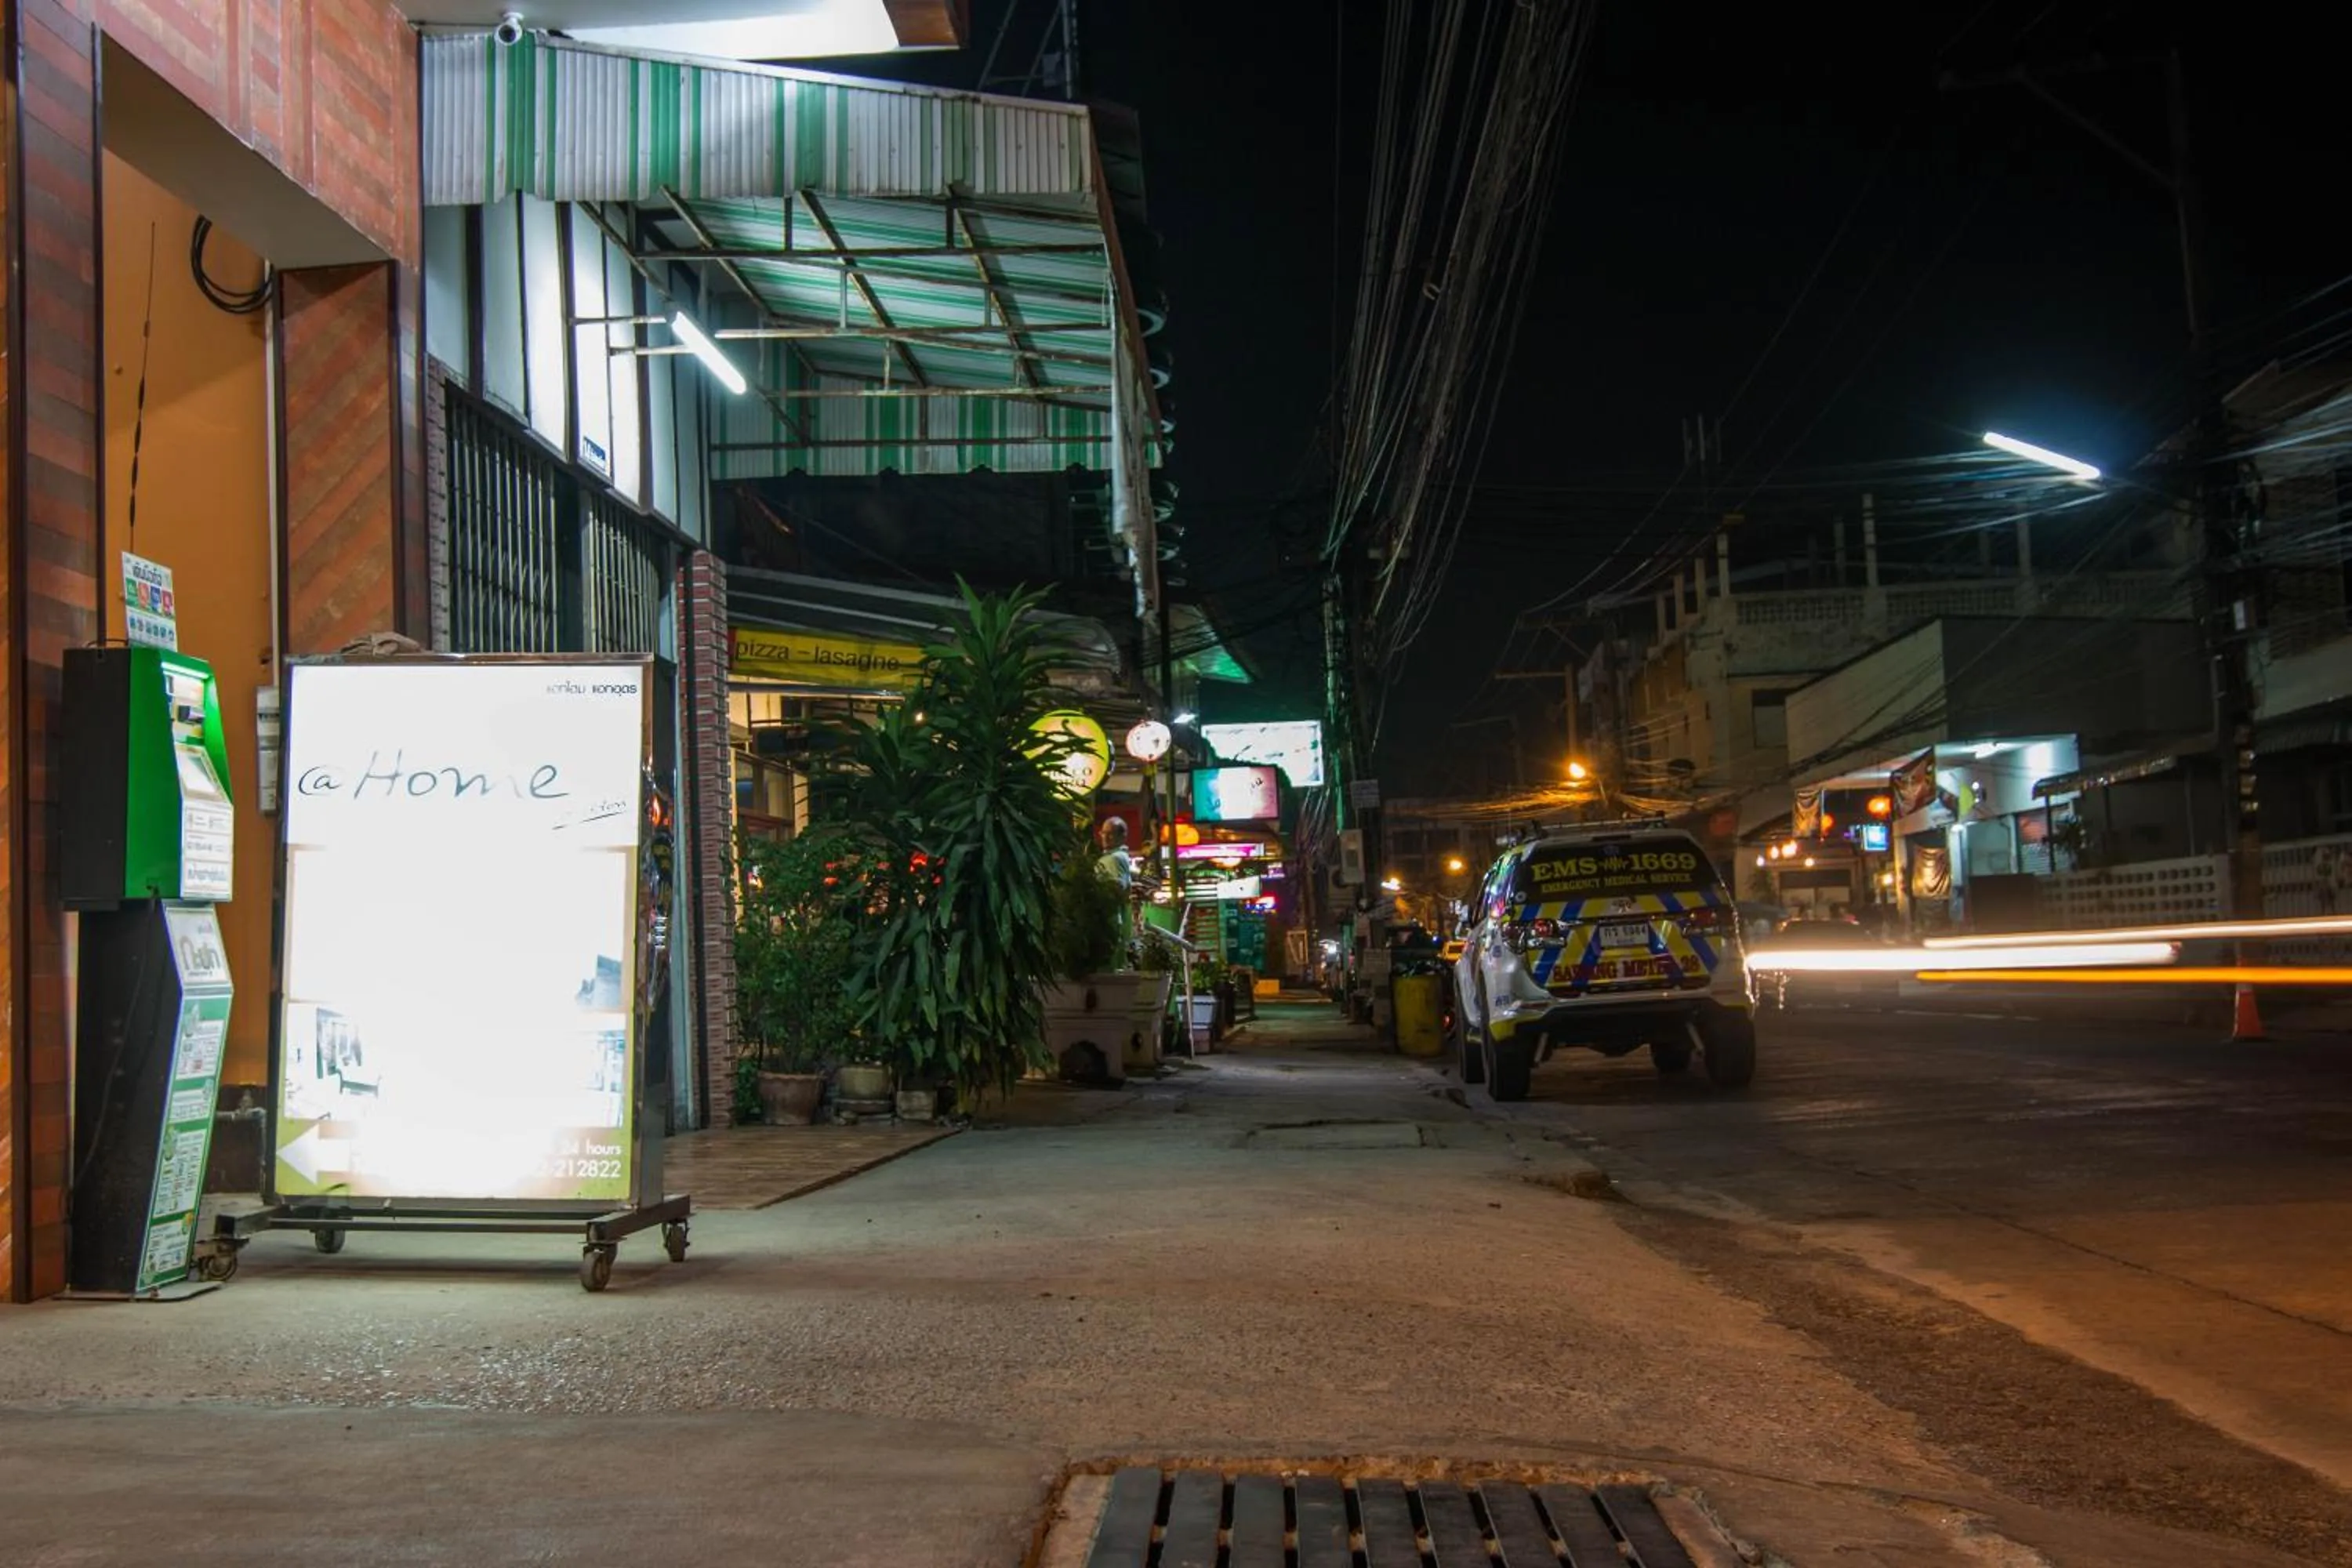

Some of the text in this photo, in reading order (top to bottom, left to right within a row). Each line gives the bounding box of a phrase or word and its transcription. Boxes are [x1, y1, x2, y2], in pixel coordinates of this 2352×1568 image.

[734, 637, 789, 659] pizza
[815, 644, 901, 673] lasagne
[1532, 853, 1697, 881] EMS 1669
[586, 1138, 622, 1155] hours
